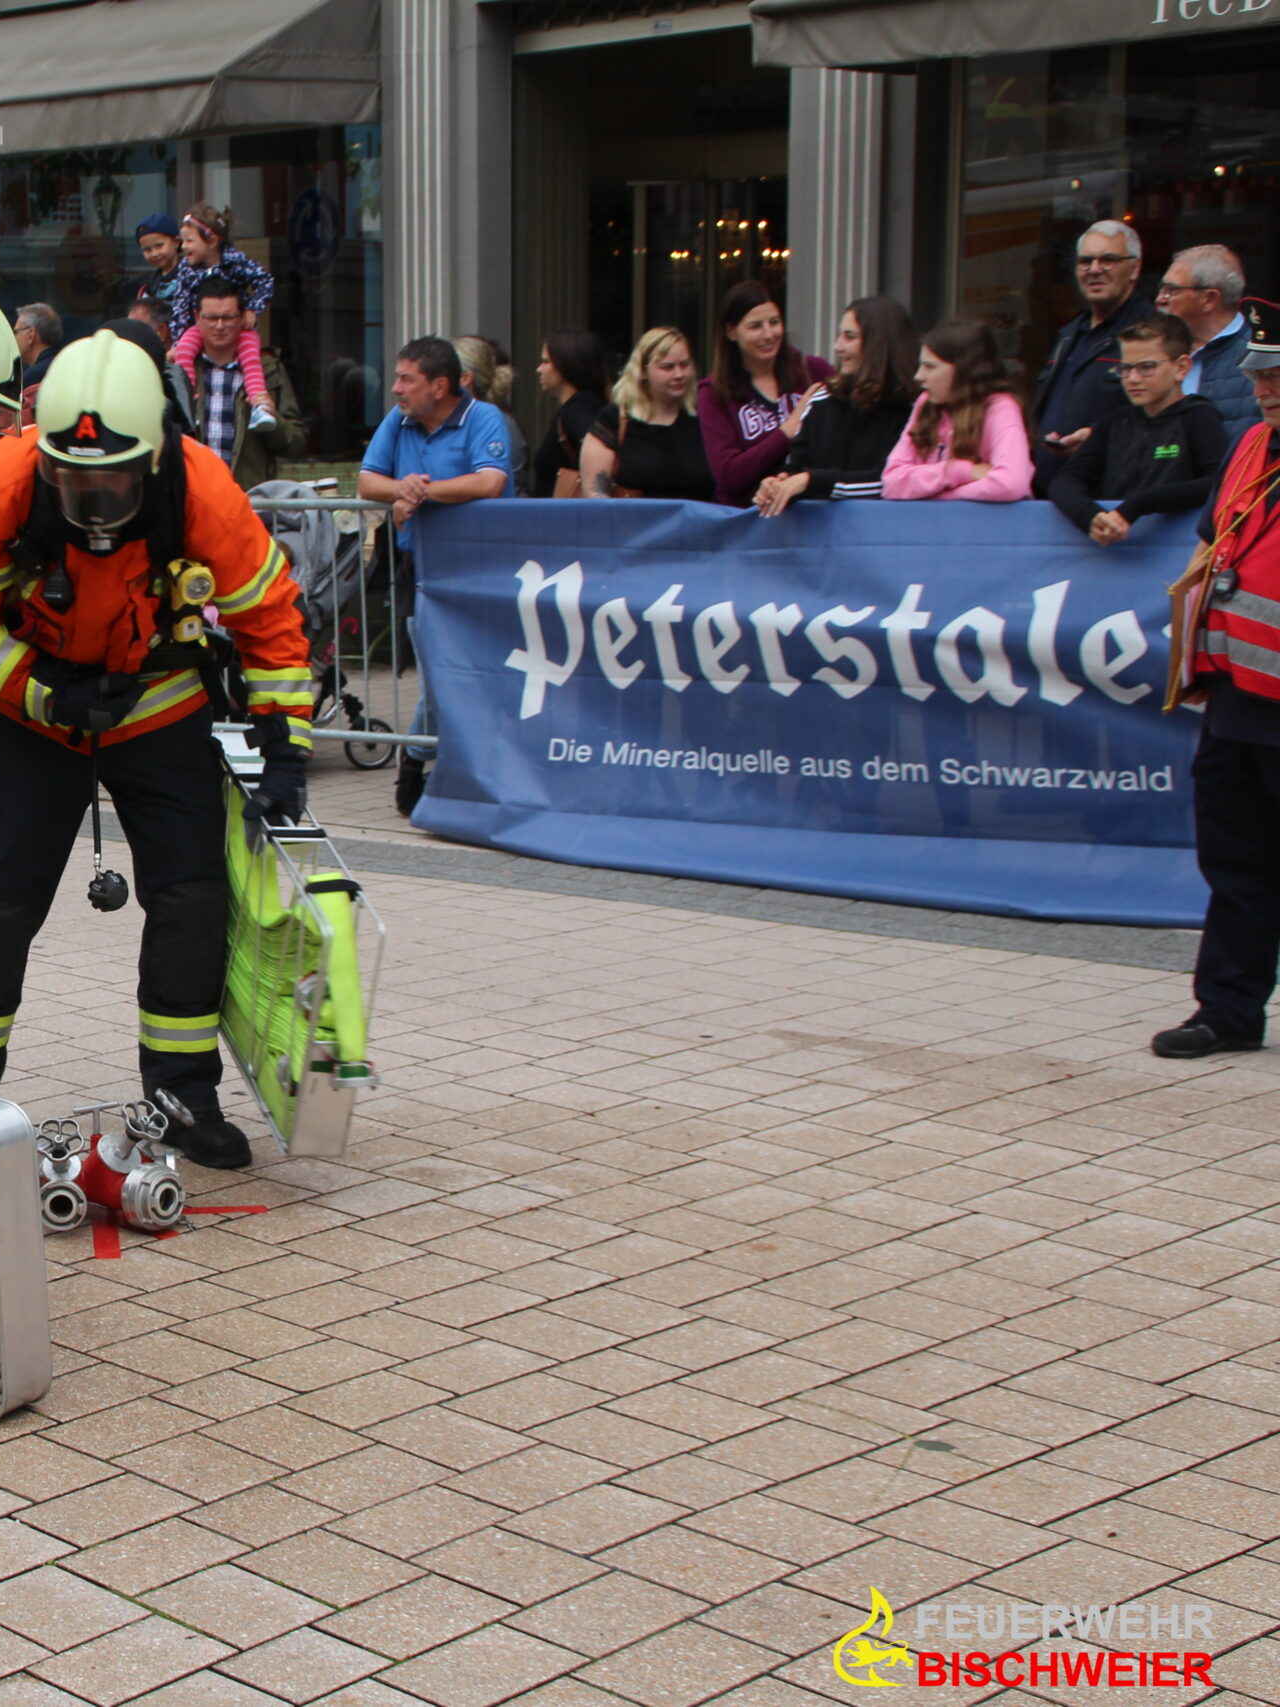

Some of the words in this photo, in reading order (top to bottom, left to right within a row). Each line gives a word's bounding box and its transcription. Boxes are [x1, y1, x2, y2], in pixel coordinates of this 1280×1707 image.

[75, 414, 98, 439] A
[504, 560, 1170, 720] Peterstale
[547, 738, 592, 763] Die
[602, 741, 790, 776] Mineralquelle
[800, 757, 852, 779] aus
[863, 755, 929, 783] dem
[940, 758, 1173, 791] Schwarzwald
